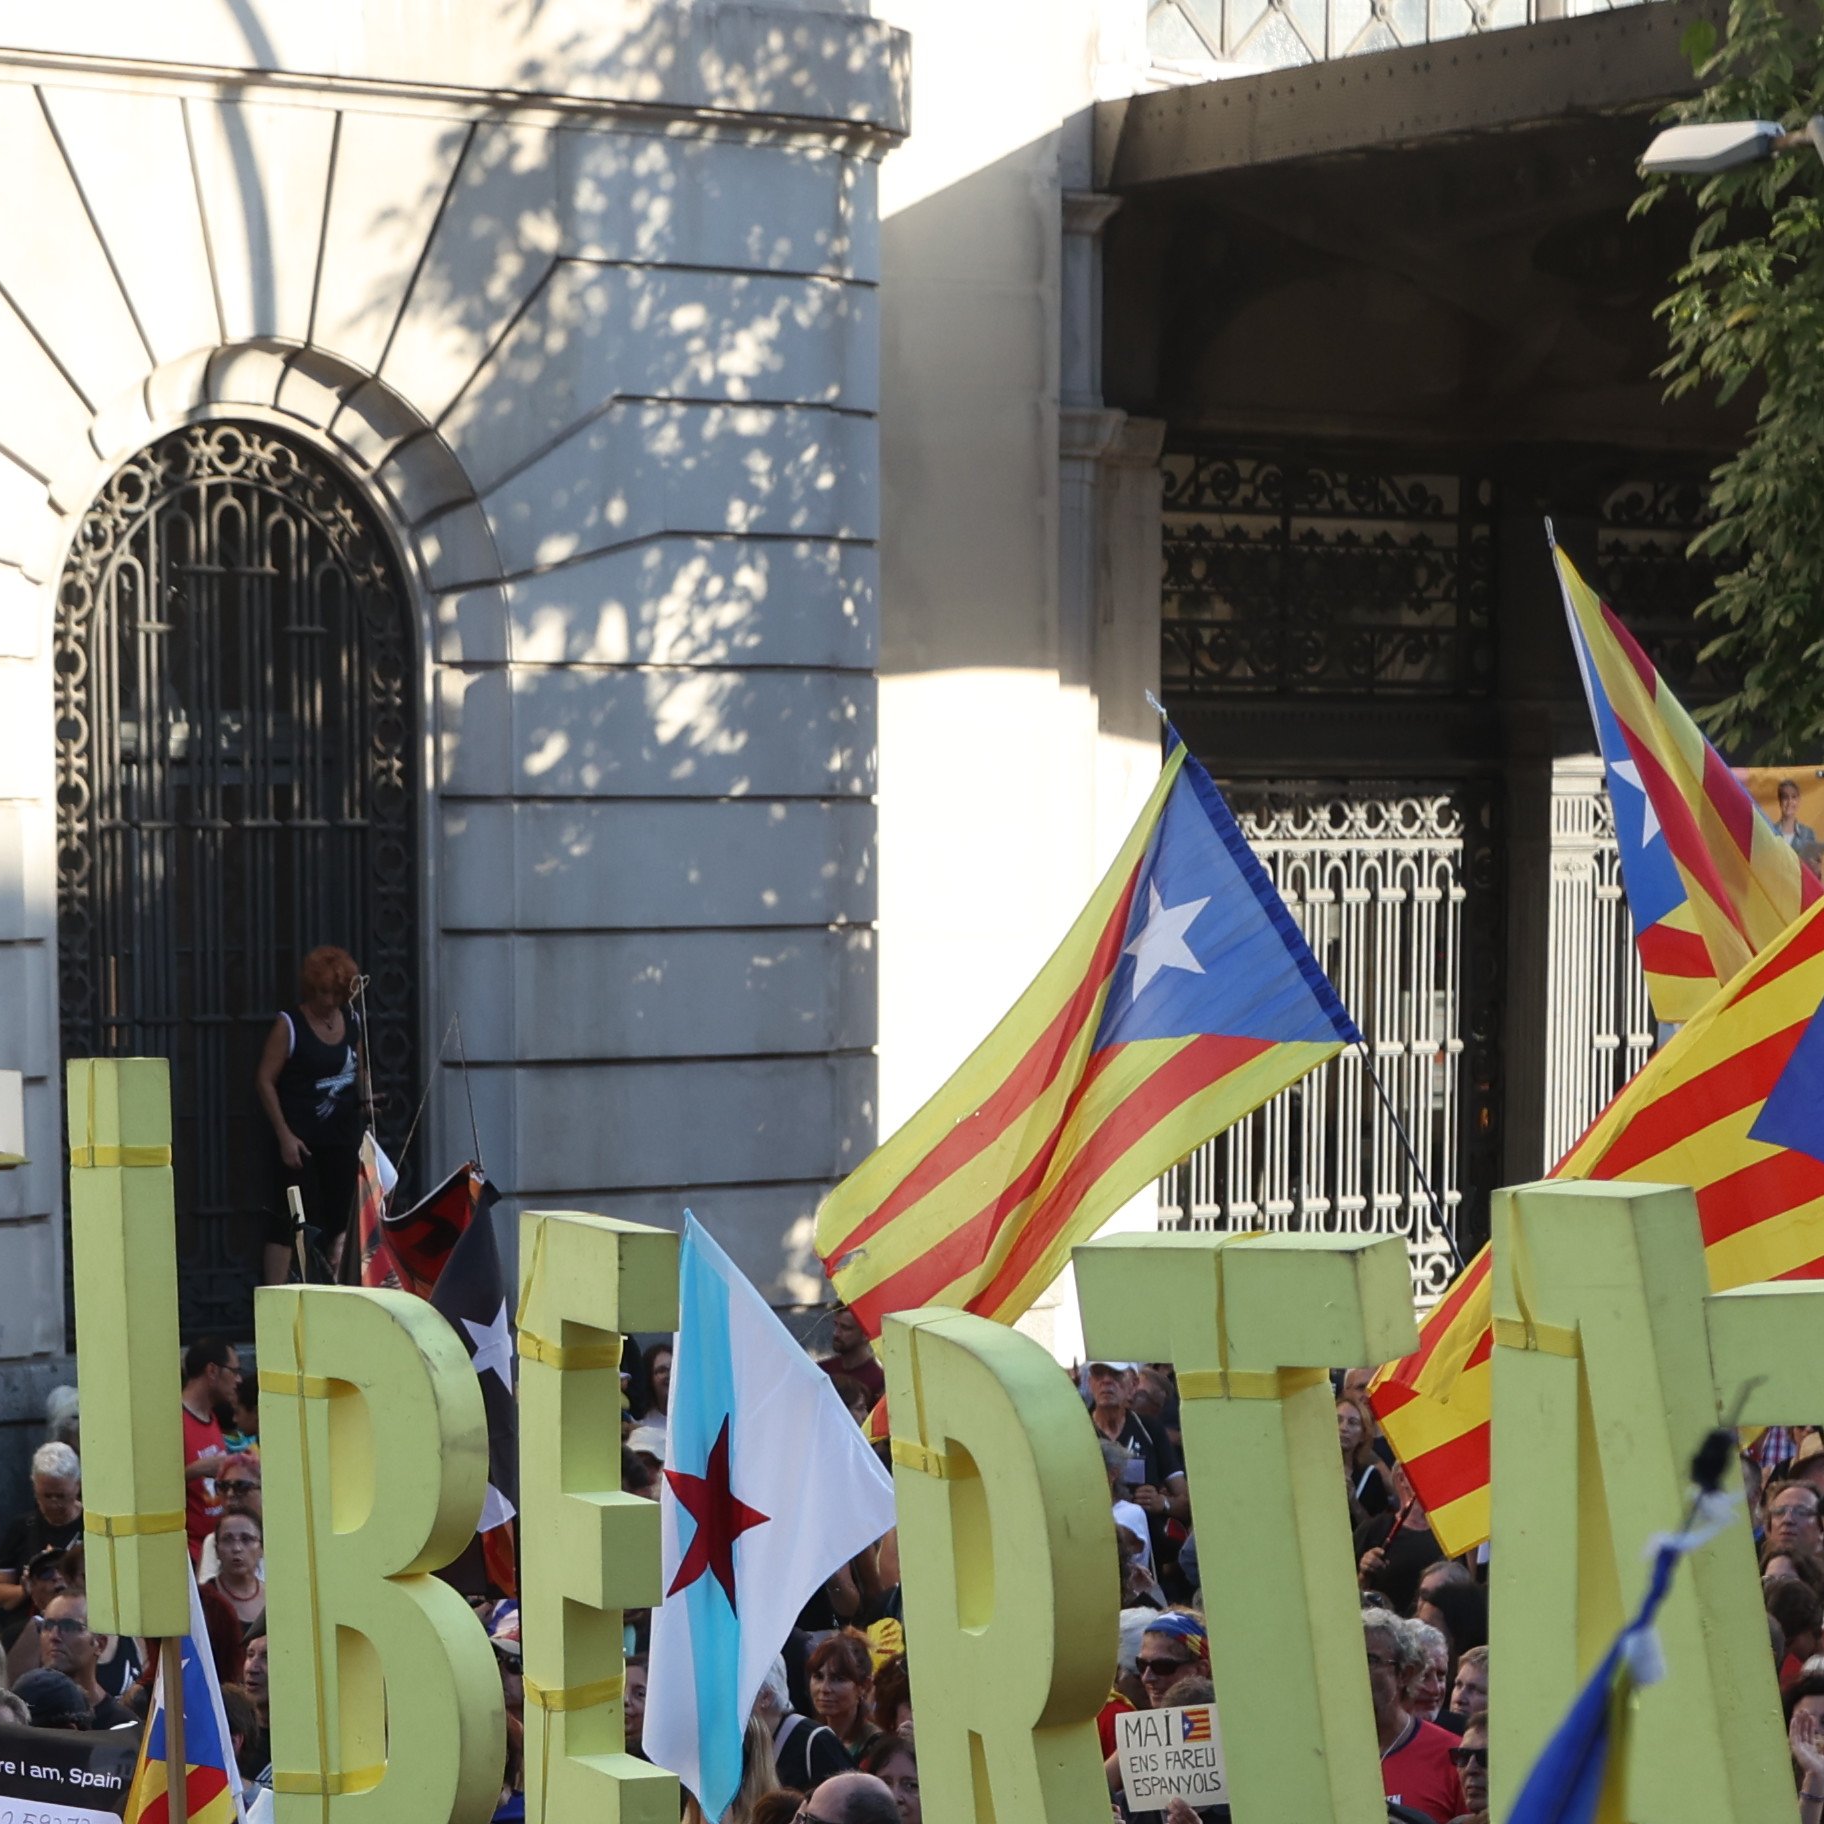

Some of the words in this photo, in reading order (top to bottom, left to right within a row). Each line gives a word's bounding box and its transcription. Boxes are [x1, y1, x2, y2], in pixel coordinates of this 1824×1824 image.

[1129, 1753, 1159, 1773] ENS
[1165, 1747, 1216, 1770] FAREU
[20, 1760, 25, 1776] I
[29, 1765, 64, 1784] am,
[69, 1768, 122, 1790] Spain
[1133, 1771, 1221, 1797] ESPANYOLS
